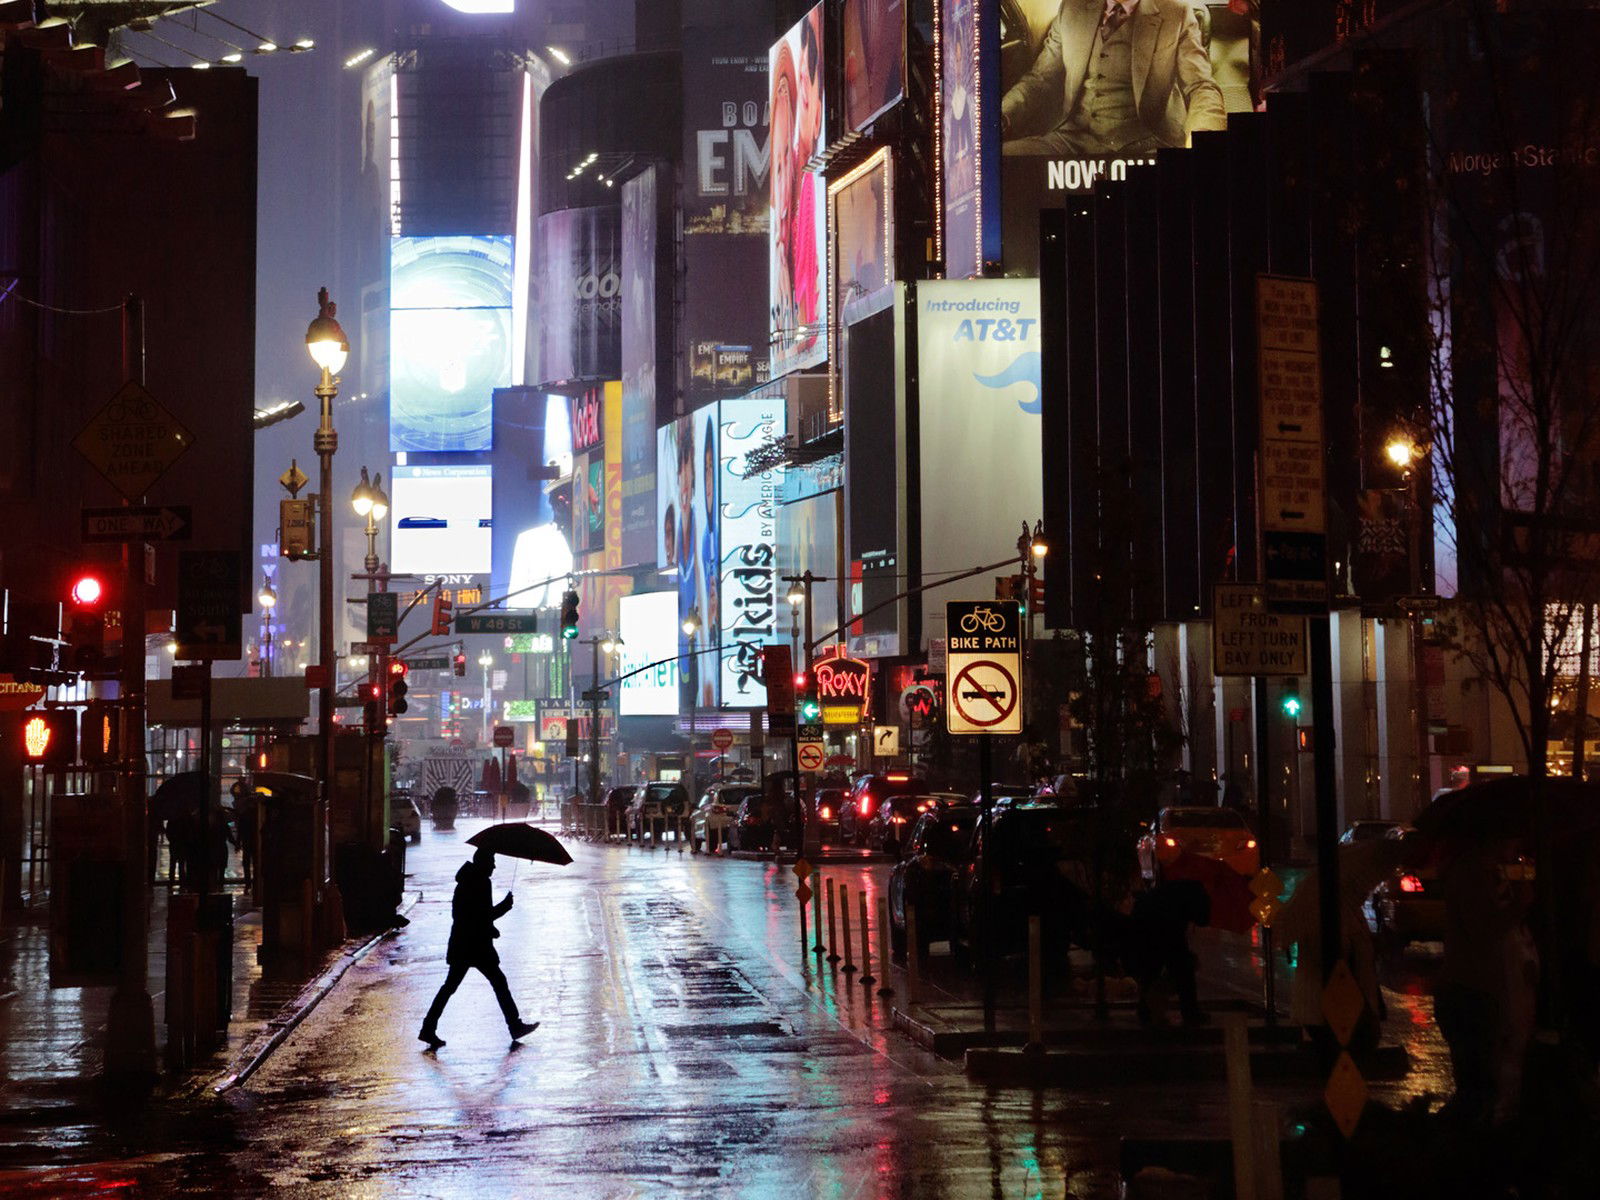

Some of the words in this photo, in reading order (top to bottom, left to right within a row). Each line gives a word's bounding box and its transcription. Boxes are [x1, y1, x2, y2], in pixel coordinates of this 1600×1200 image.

[1047, 160, 1106, 190] NOW
[925, 298, 1021, 316] Introducing
[952, 317, 1037, 343] AT&T
[572, 386, 600, 450] Kodak
[99, 426, 168, 441] SHARED
[111, 442, 156, 458] ZONE
[105, 460, 168, 475] AHEAD
[97, 518, 128, 533] ONE
[143, 516, 176, 532] WAY
[761, 521, 774, 538] BY
[424, 574, 474, 585] SONY
[733, 542, 774, 637] kids
[470, 619, 482, 630] W
[486, 618, 504, 630] 48
[507, 618, 523, 630] St
[1240, 612, 1279, 627] FROM
[950, 636, 980, 649] BIKE
[984, 636, 1018, 649] PATH
[1221, 631, 1255, 647] LEFT
[1260, 631, 1299, 647] TURN
[1224, 651, 1250, 666] BAY
[1260, 651, 1296, 666] ONLY
